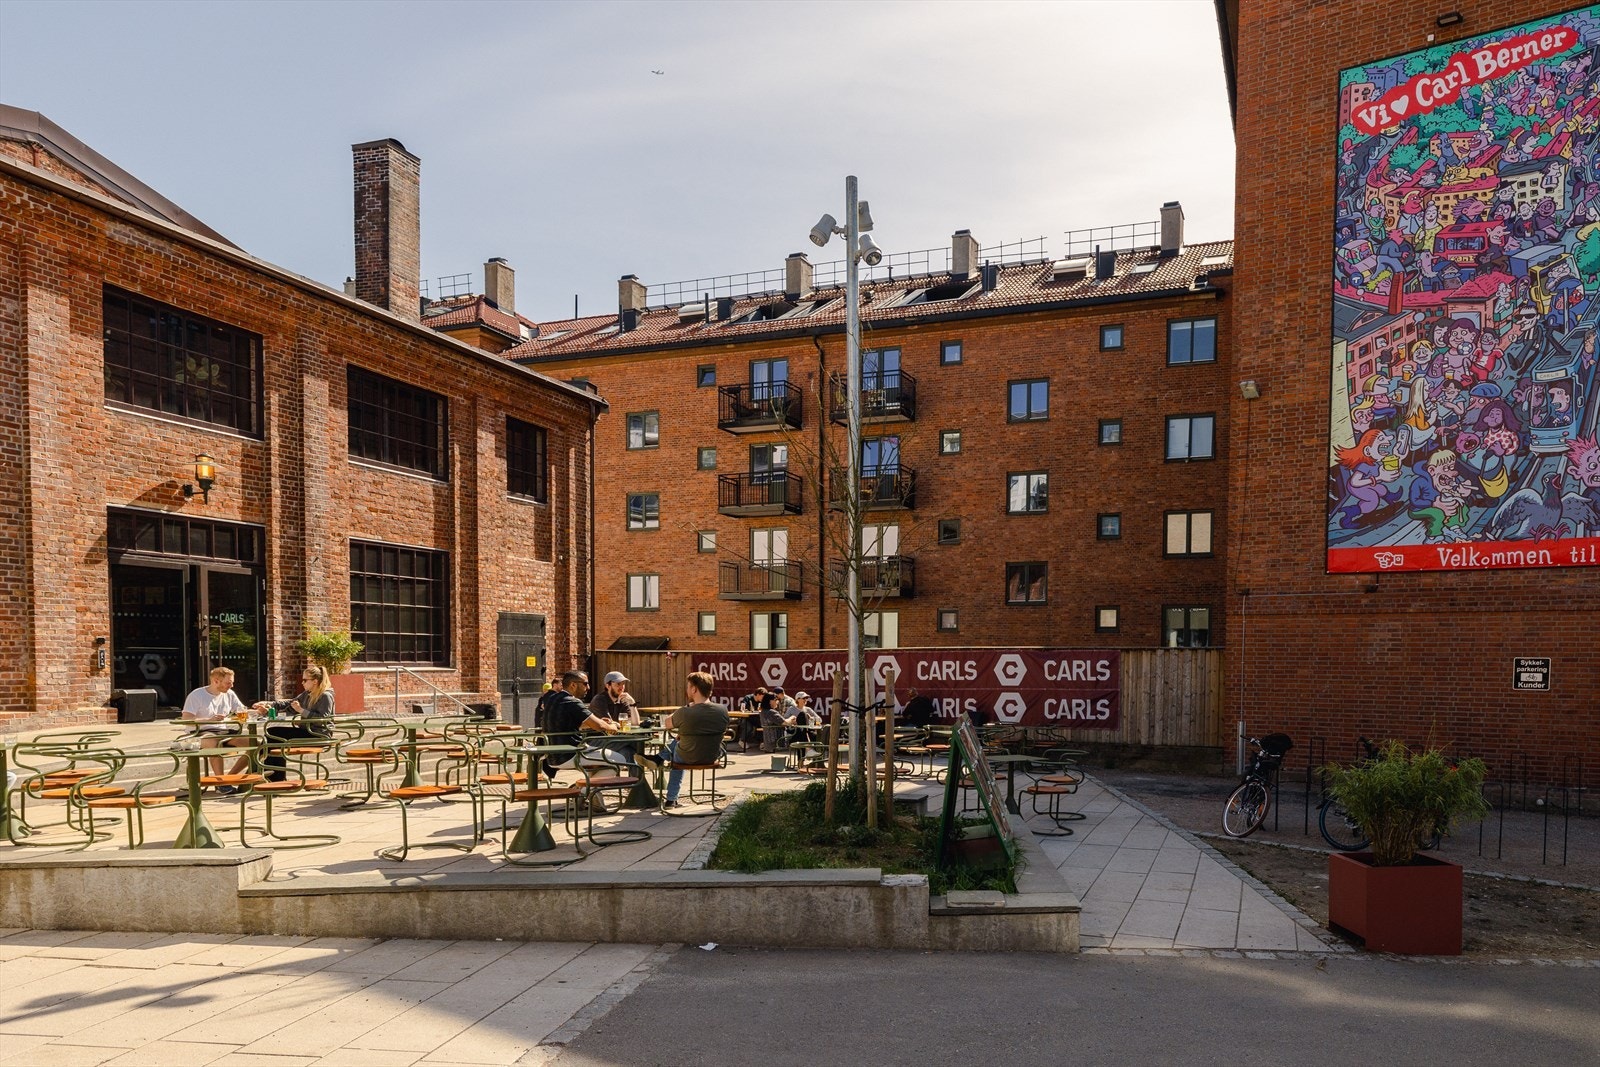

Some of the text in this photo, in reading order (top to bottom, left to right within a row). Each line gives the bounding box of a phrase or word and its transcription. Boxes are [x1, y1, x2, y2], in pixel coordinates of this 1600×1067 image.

[1357, 30, 1567, 128] Vi Carl Berner
[1437, 545, 1597, 567] Velkommen til
[219, 612, 245, 624] CARLS
[917, 660, 978, 681] CARLS
[1043, 660, 1111, 681] CARLS
[929, 697, 977, 718] ARLS
[1044, 698, 1110, 720] CARLS
